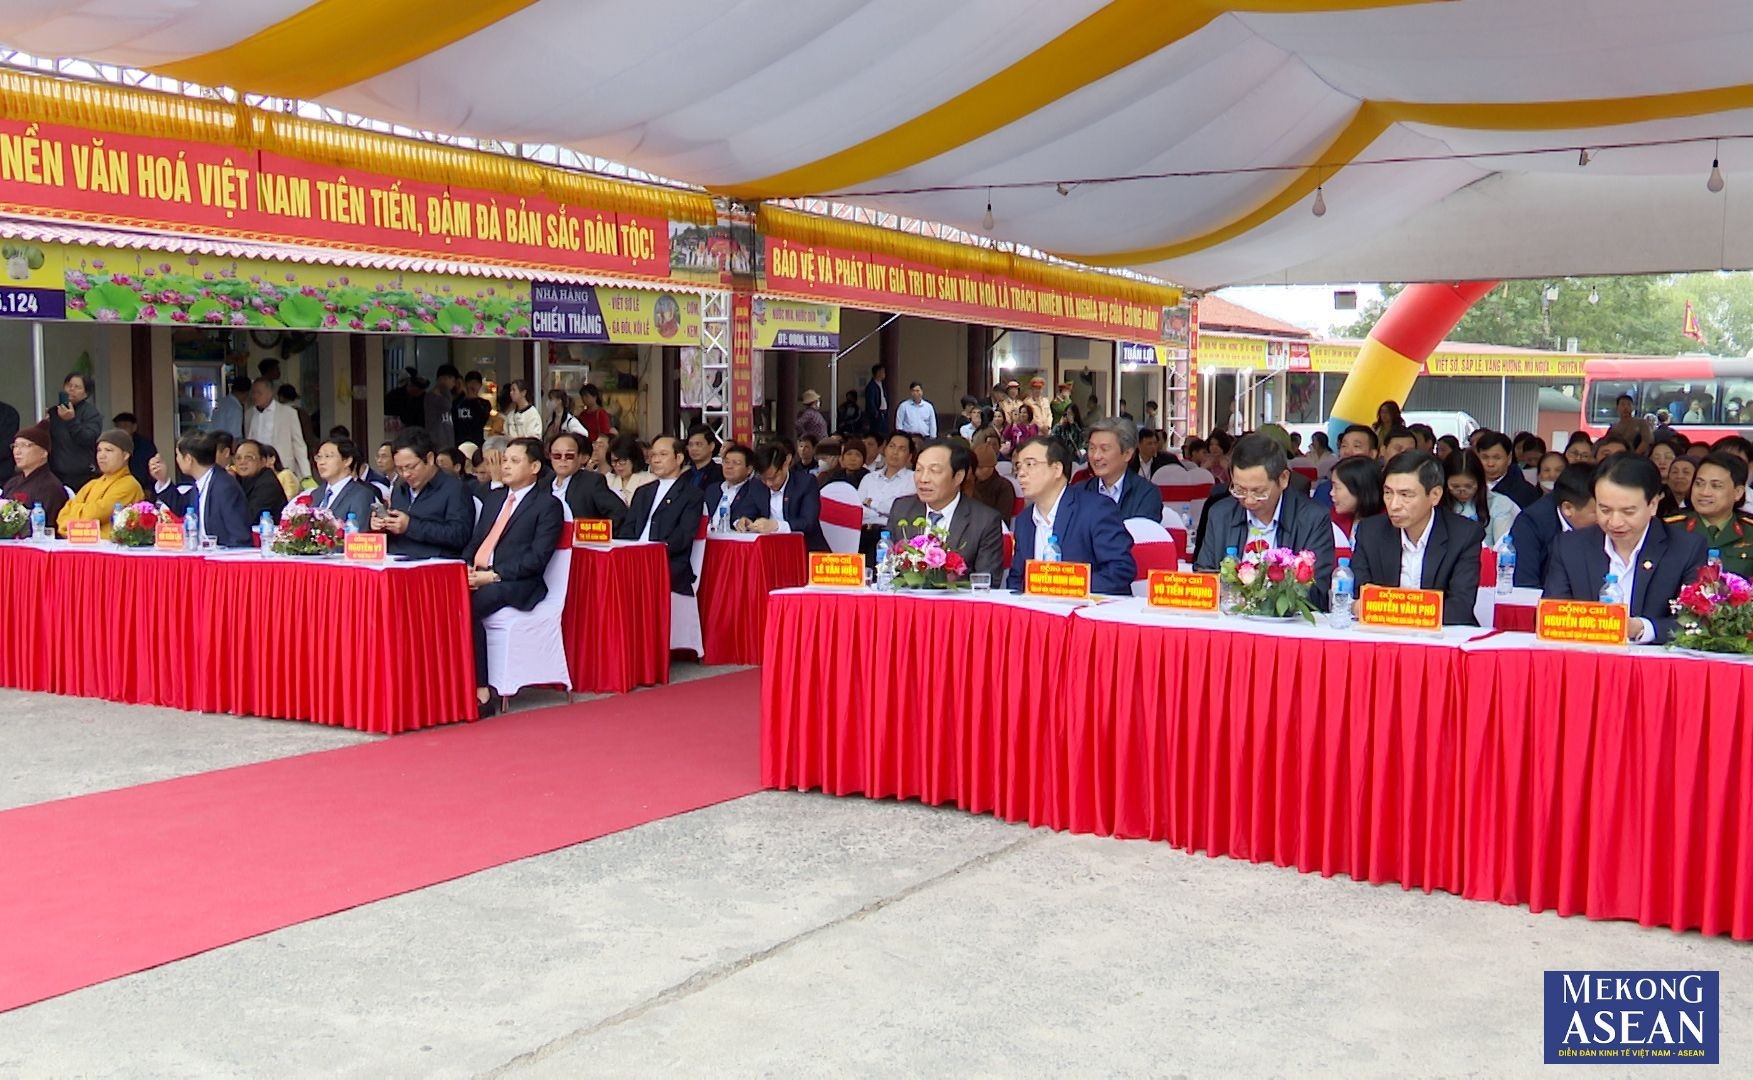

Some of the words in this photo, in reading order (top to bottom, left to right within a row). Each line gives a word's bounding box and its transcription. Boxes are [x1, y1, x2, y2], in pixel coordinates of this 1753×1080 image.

[0, 122, 65, 187] NỀN
[71, 137, 130, 196] VĂN
[136, 150, 192, 204] HOÁ
[197, 157, 249, 219] VIỆT
[256, 171, 312, 219] NAM
[316, 175, 367, 226] TIÊN
[370, 180, 423, 237] TIẾN,
[427, 191, 472, 244] ĐẬM
[476, 198, 502, 242] ĐÀ
[505, 198, 543, 246] BẢN
[547, 203, 580, 250] SẮC
[584, 213, 618, 256] DÂN
[620, 219, 656, 266] TỘC!
[772, 239, 798, 279] BẢO
[800, 247, 816, 288] VỆ
[817, 250, 834, 284] VÀ
[835, 255, 863, 288] PHÁT
[865, 263, 886, 291] HUY
[888, 264, 907, 294] GIÁ
[907, 269, 924, 303] TRỊ
[925, 272, 936, 299] DI
[937, 269, 958, 302] SẢN
[958, 274, 978, 304] VĂN
[978, 279, 998, 308] HOÁ
[998, 281, 1010, 310] LÀ
[1010, 283, 1037, 312] TRÁCH
[1037, 289, 1064, 322] NHIỆM
[1063, 291, 1076, 319] VÀ
[535, 287, 558, 301] NHÀ
[559, 287, 589, 304] HÀNG
[532, 305, 566, 334] CHIẾN
[567, 306, 602, 335] THẮNG
[1366, 599, 1399, 613] NGUYỄN
[1558, 603, 1587, 614] ĐỒNG
[1589, 605, 1607, 615] CHÍ
[1544, 614, 1577, 628] NGUYỄN
